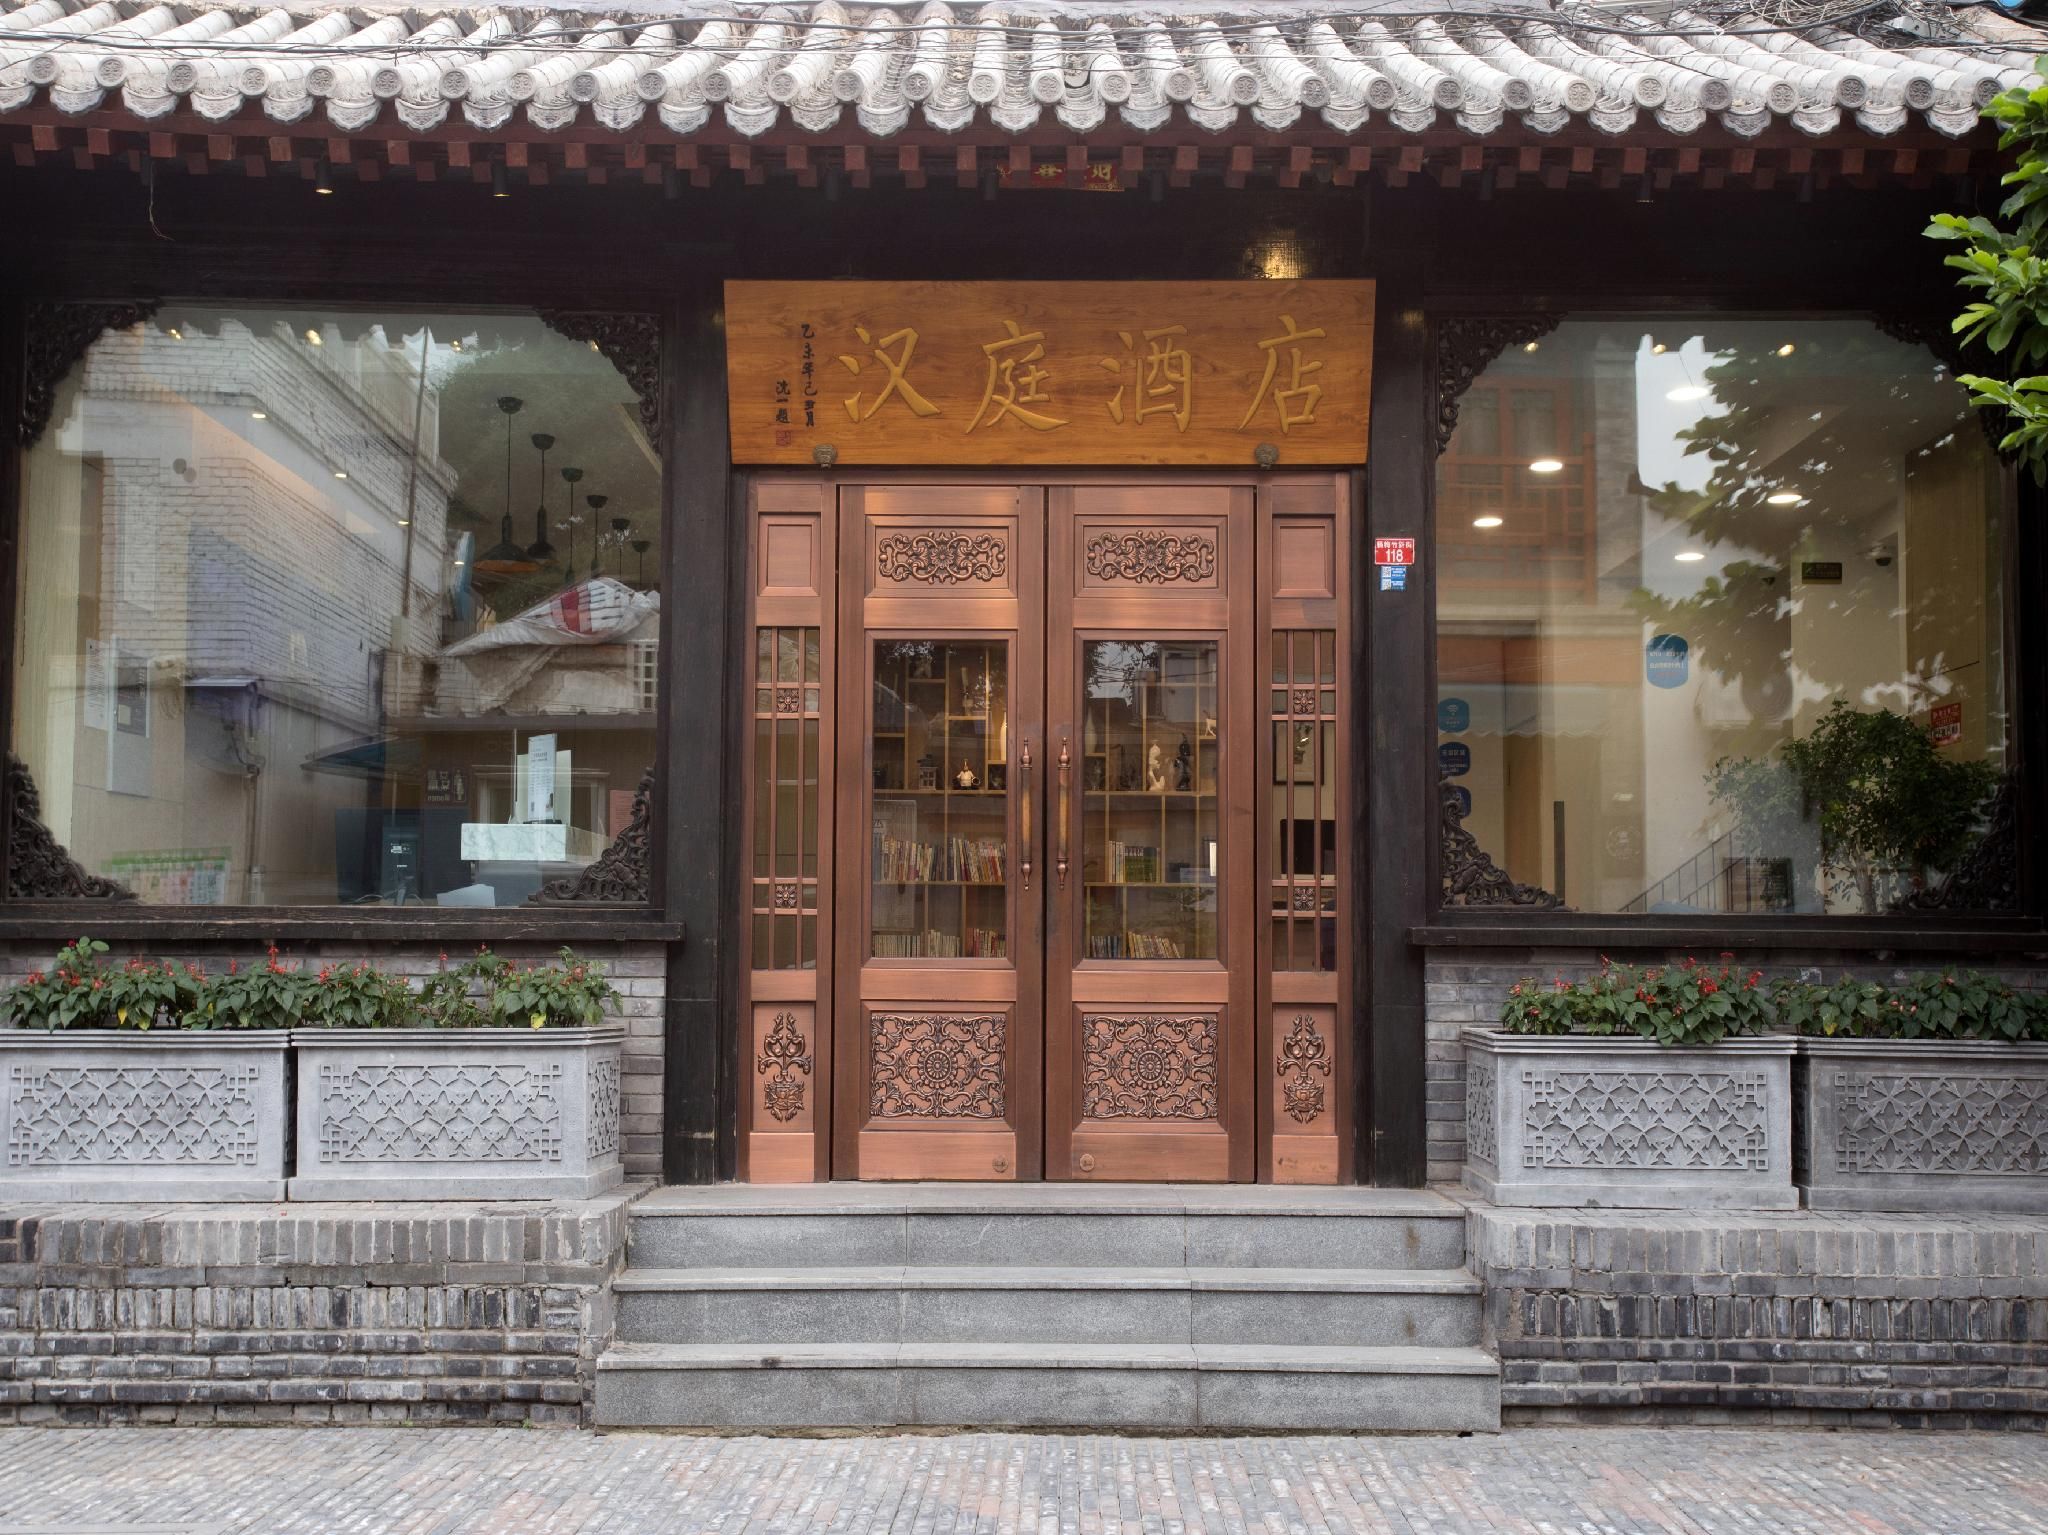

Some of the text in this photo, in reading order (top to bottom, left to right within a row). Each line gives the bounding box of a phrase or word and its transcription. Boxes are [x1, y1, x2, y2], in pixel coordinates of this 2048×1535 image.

[836, 314, 1327, 434] 汉庭酒店
[1386, 550, 1403, 562] 118
